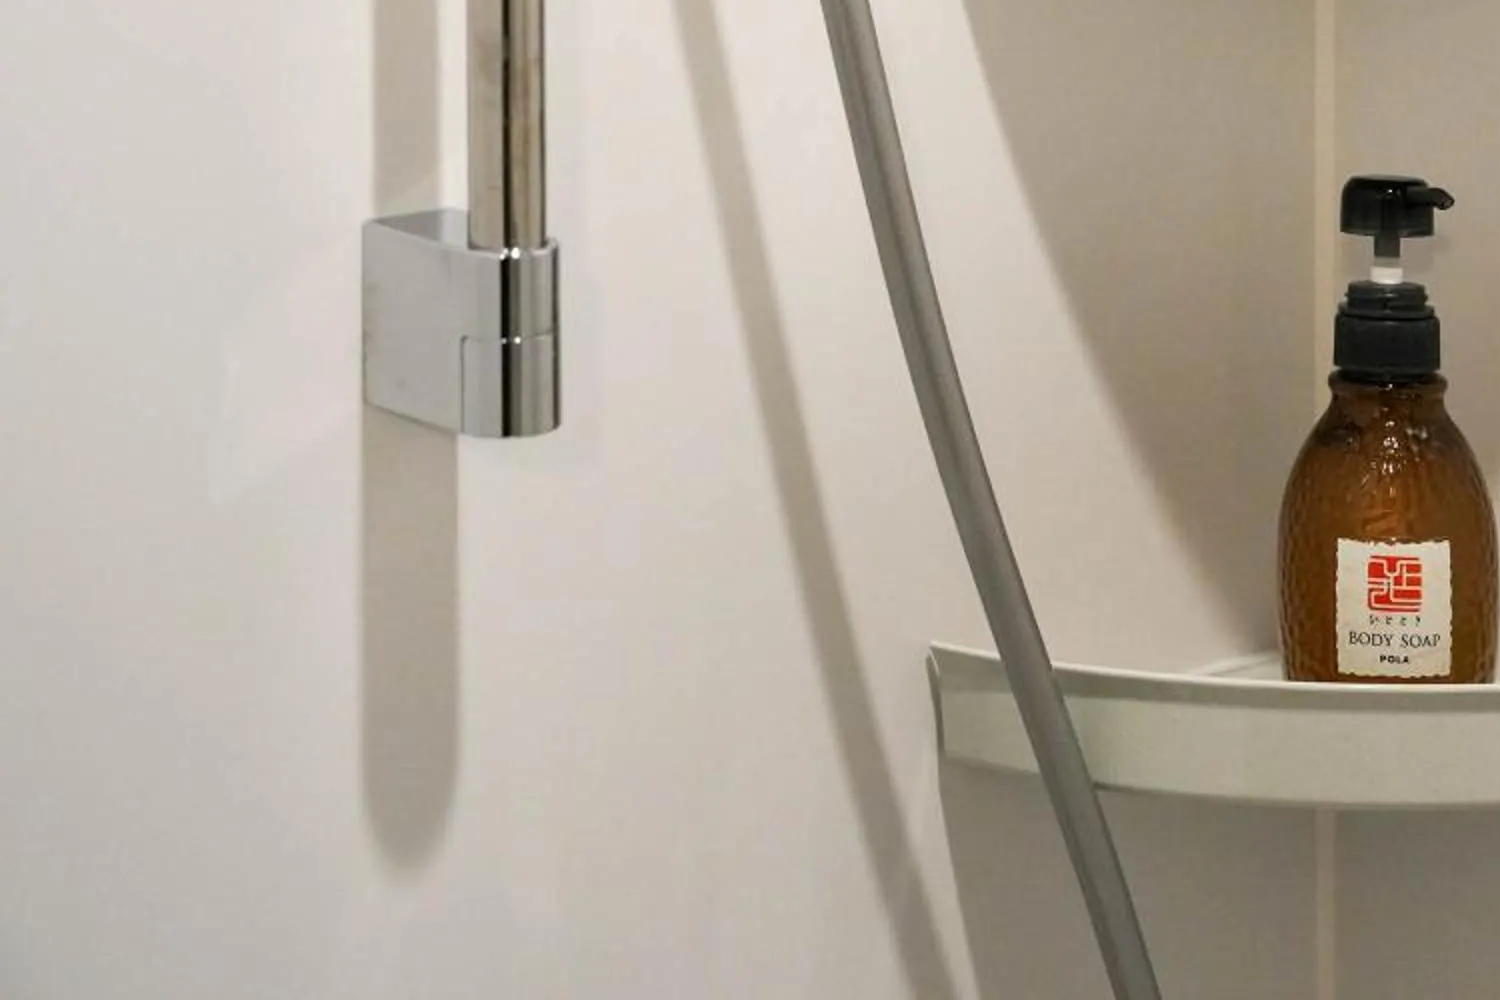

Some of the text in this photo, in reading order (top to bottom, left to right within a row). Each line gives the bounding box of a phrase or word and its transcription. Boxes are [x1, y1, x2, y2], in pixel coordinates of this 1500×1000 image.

[1348, 631, 1441, 648] BODY SOAP
[1379, 655, 1409, 664] POLA
